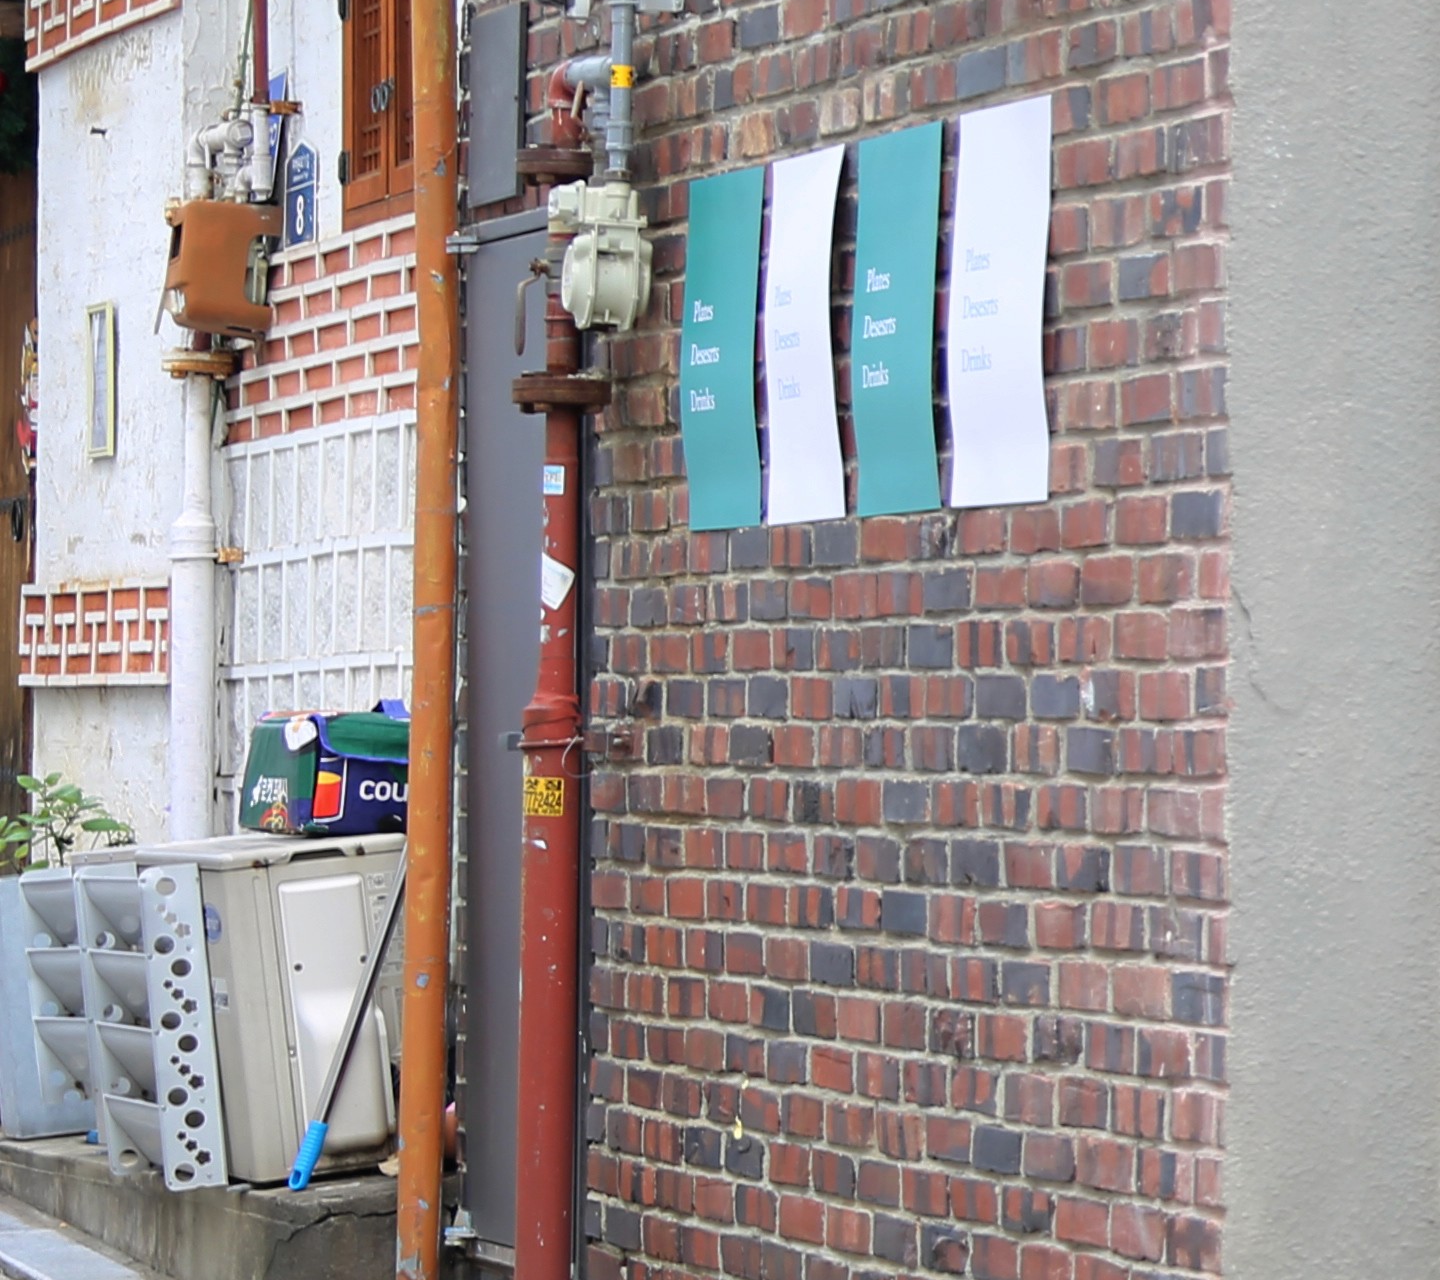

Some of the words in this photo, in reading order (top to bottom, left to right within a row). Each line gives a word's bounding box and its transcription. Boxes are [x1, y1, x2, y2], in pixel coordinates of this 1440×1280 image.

[296, 194, 305, 236] 8
[865, 267, 890, 293] Plates
[961, 345, 992, 372] Drinks
[862, 361, 889, 389] Drinks
[690, 387, 715, 412] Drinks
